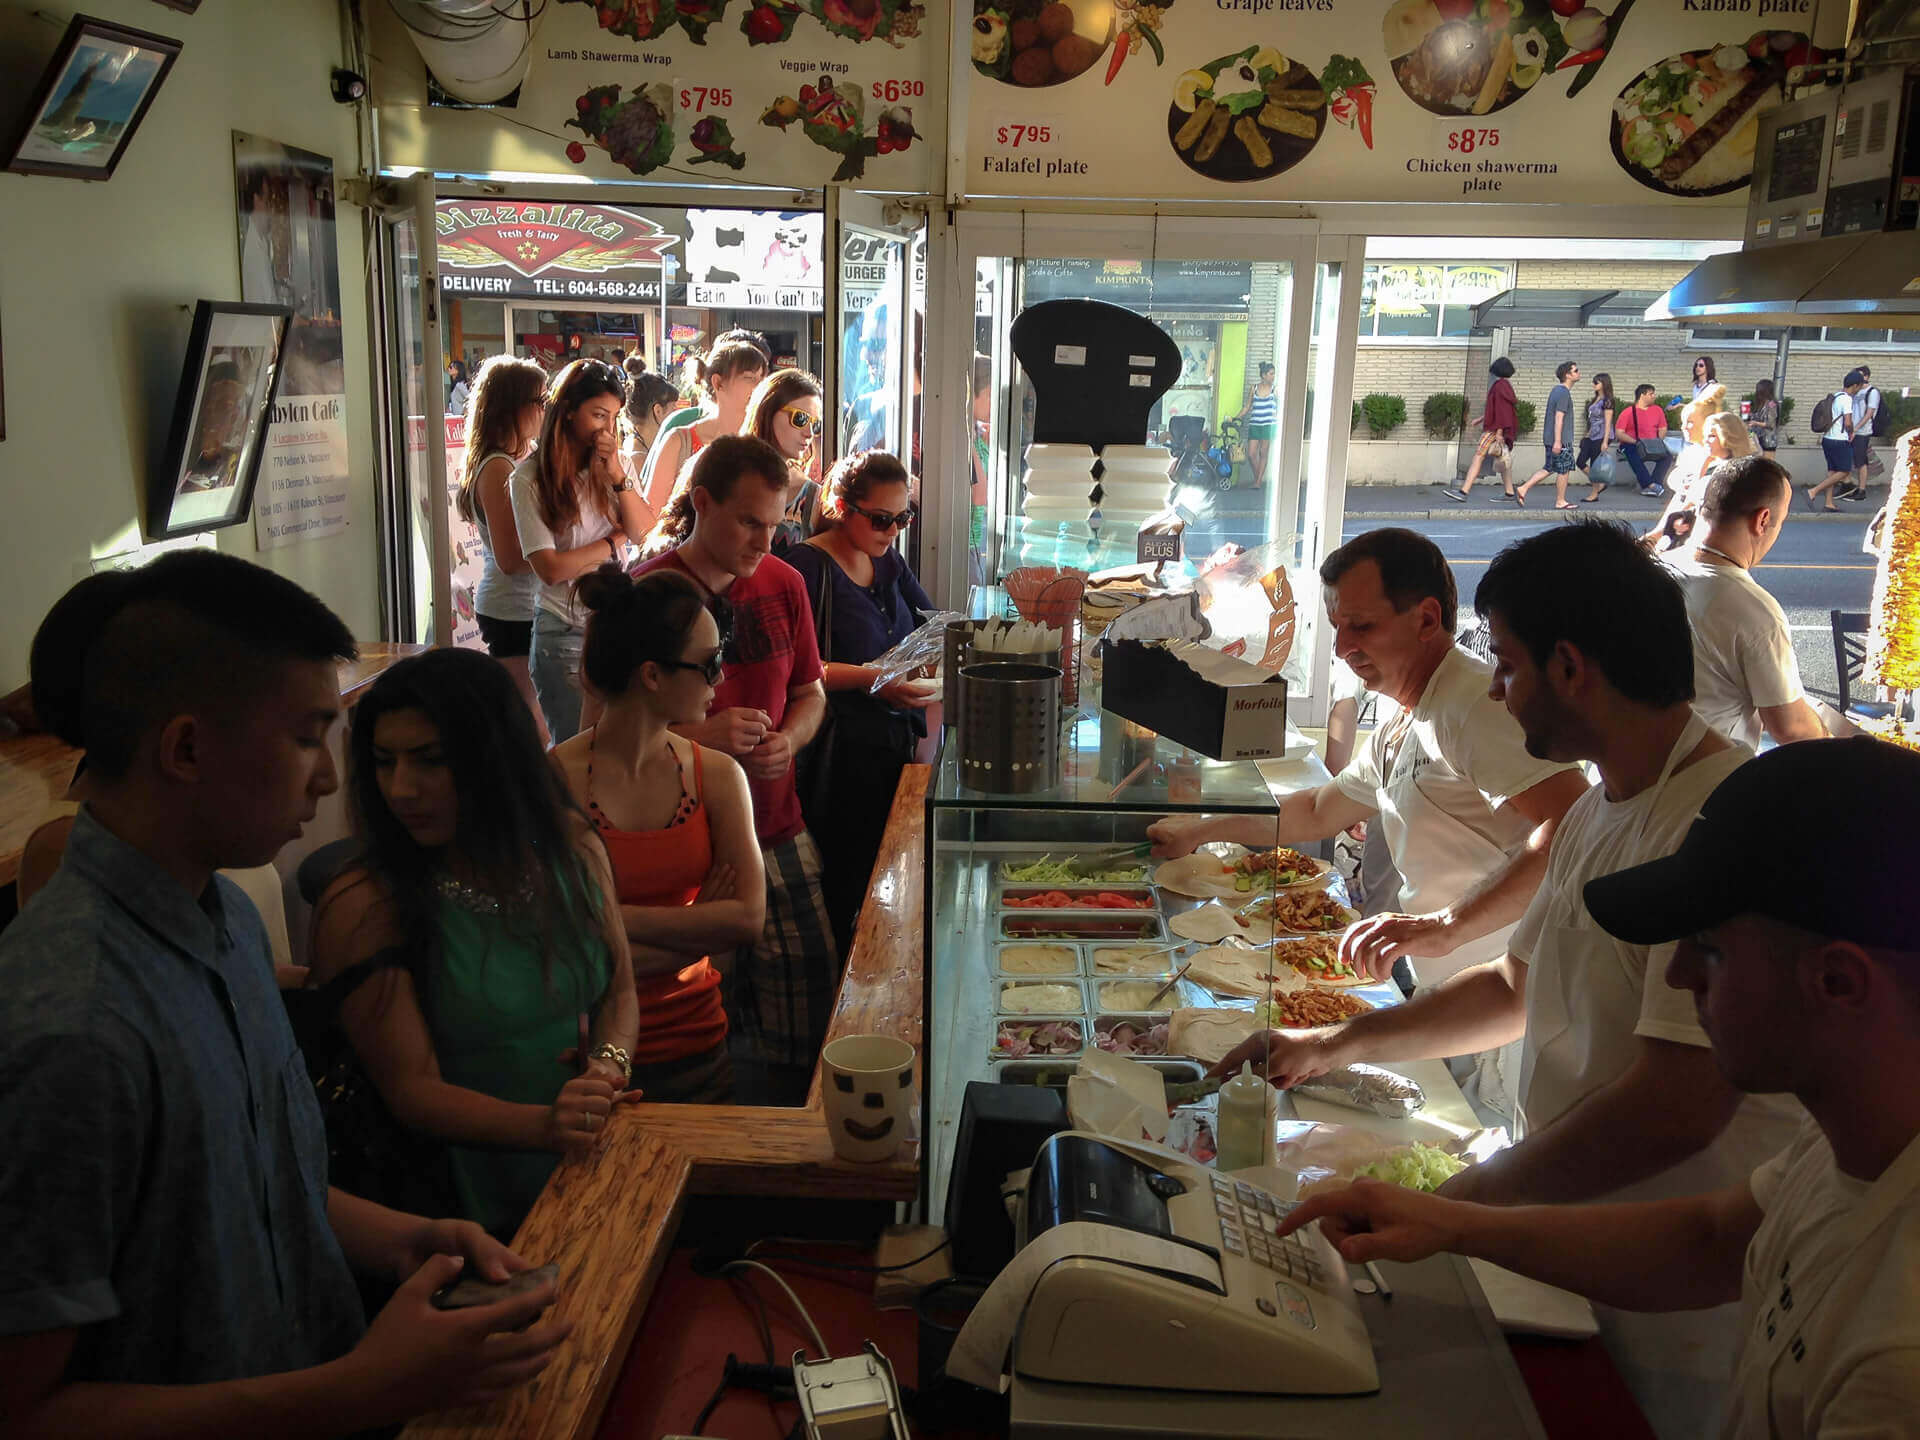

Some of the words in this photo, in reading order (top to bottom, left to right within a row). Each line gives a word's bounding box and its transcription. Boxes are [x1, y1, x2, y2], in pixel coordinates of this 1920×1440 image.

[1217, 0, 1273, 14] Grape
[1280, 0, 1334, 11] leaves
[1684, 0, 1751, 12] Kabab
[1758, 0, 1810, 16] plate
[548, 48, 578, 61] Lamb
[582, 50, 639, 63] Shawerma
[643, 53, 672, 67] Wrap
[780, 59, 816, 73] Veggie
[820, 61, 849, 75] Wrap
[983, 156, 1040, 173] Falafel
[1045, 158, 1088, 178] plate
[1406, 158, 1471, 173] Chicken
[1476, 160, 1558, 174] shawerma
[1463, 177, 1502, 194] plate
[845, 265, 886, 280] URGER
[443, 276, 512, 293] DELIVERY
[534, 279, 565, 294] TEL:
[568, 280, 661, 297] 604-568-2441
[695, 286, 712, 303] Eat
[715, 287, 726, 303] in
[746, 288, 769, 305] You
[775, 290, 804, 307] Can't
[270, 402, 309, 425] bylon
[312, 399, 340, 422] Café
[1144, 545, 1174, 557] PLUS
